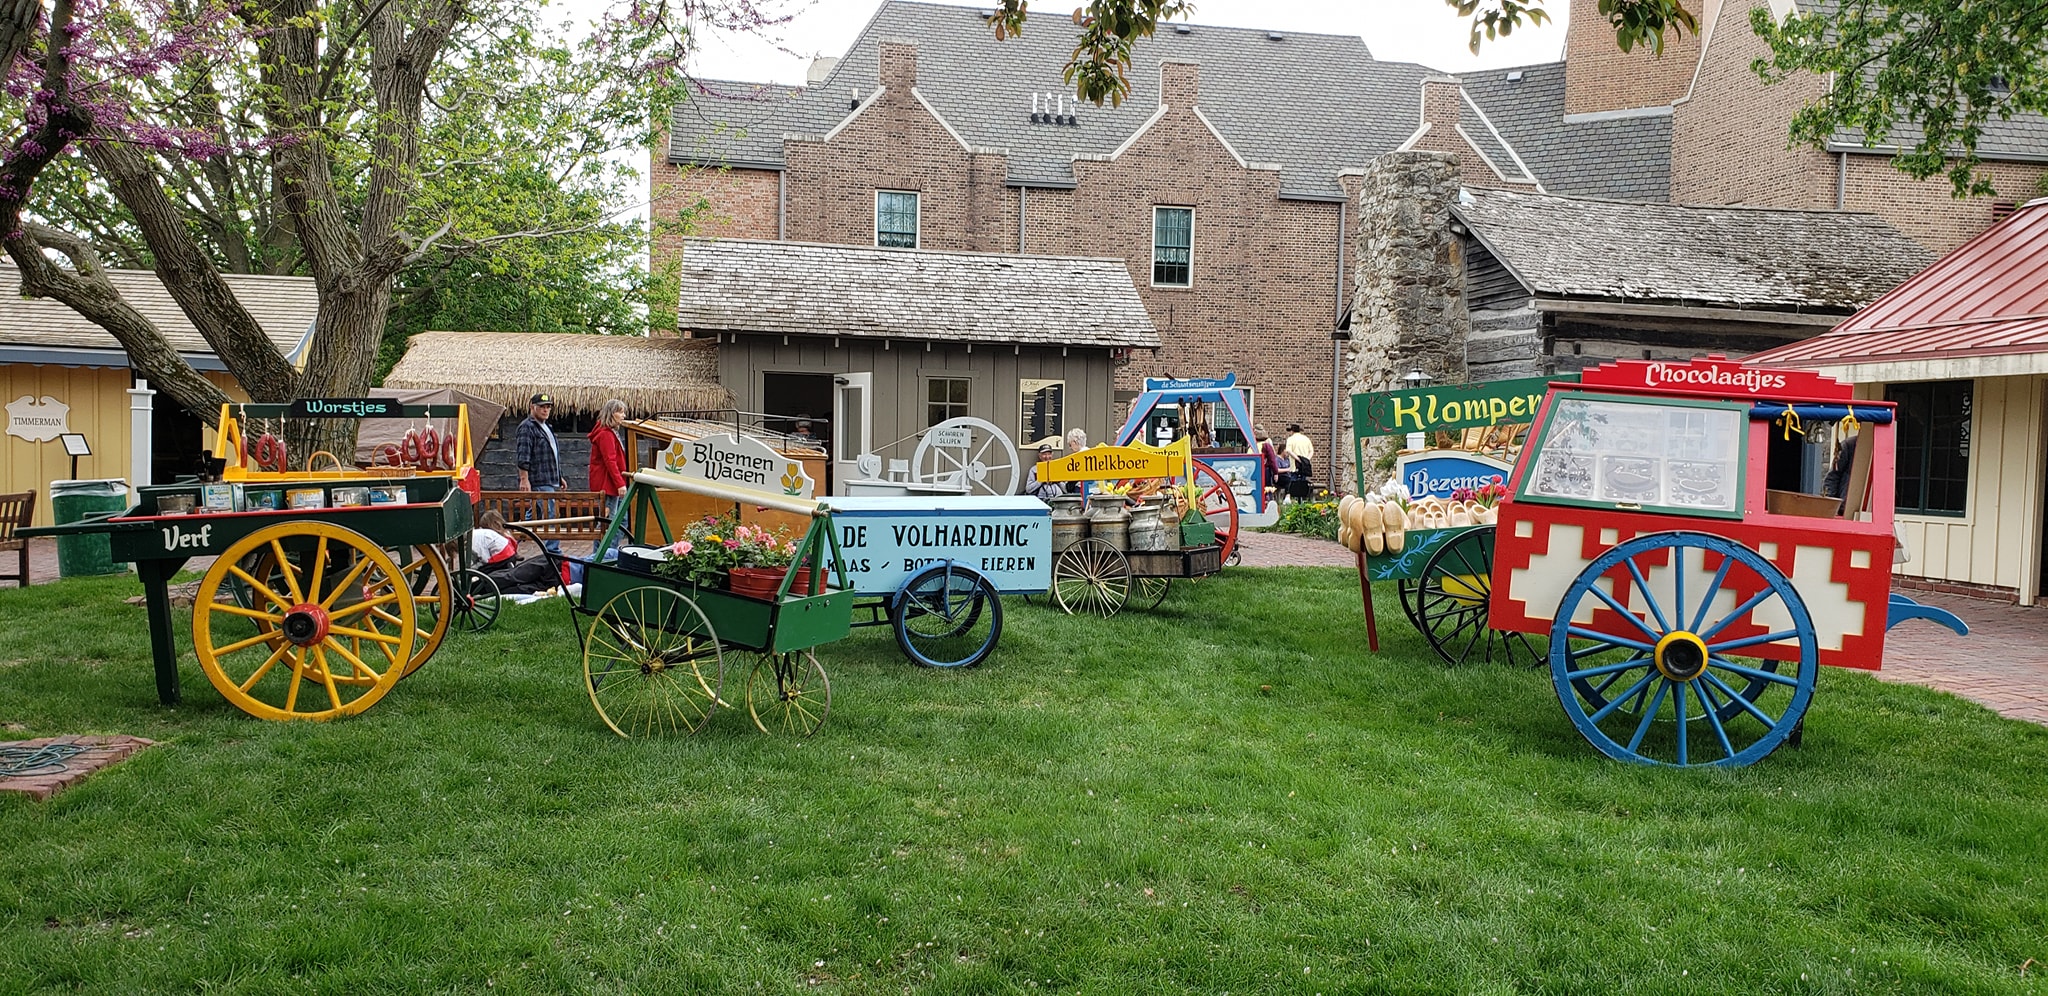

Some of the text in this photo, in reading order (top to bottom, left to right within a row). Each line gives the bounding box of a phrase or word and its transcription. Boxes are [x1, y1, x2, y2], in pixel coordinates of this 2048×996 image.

[1645, 362, 1786, 393] Chocolaatjes
[305, 400, 387, 416] Worstjes
[13, 416, 61, 426] TIMMERMAN
[693, 443, 773, 471] Bloemen
[1066, 454, 1149, 472] de Melkboer
[704, 460, 765, 485] Wagen
[1410, 468, 1491, 497] Bezems
[162, 524, 212, 551] Verf
[981, 557, 1035, 571] EIEREN
